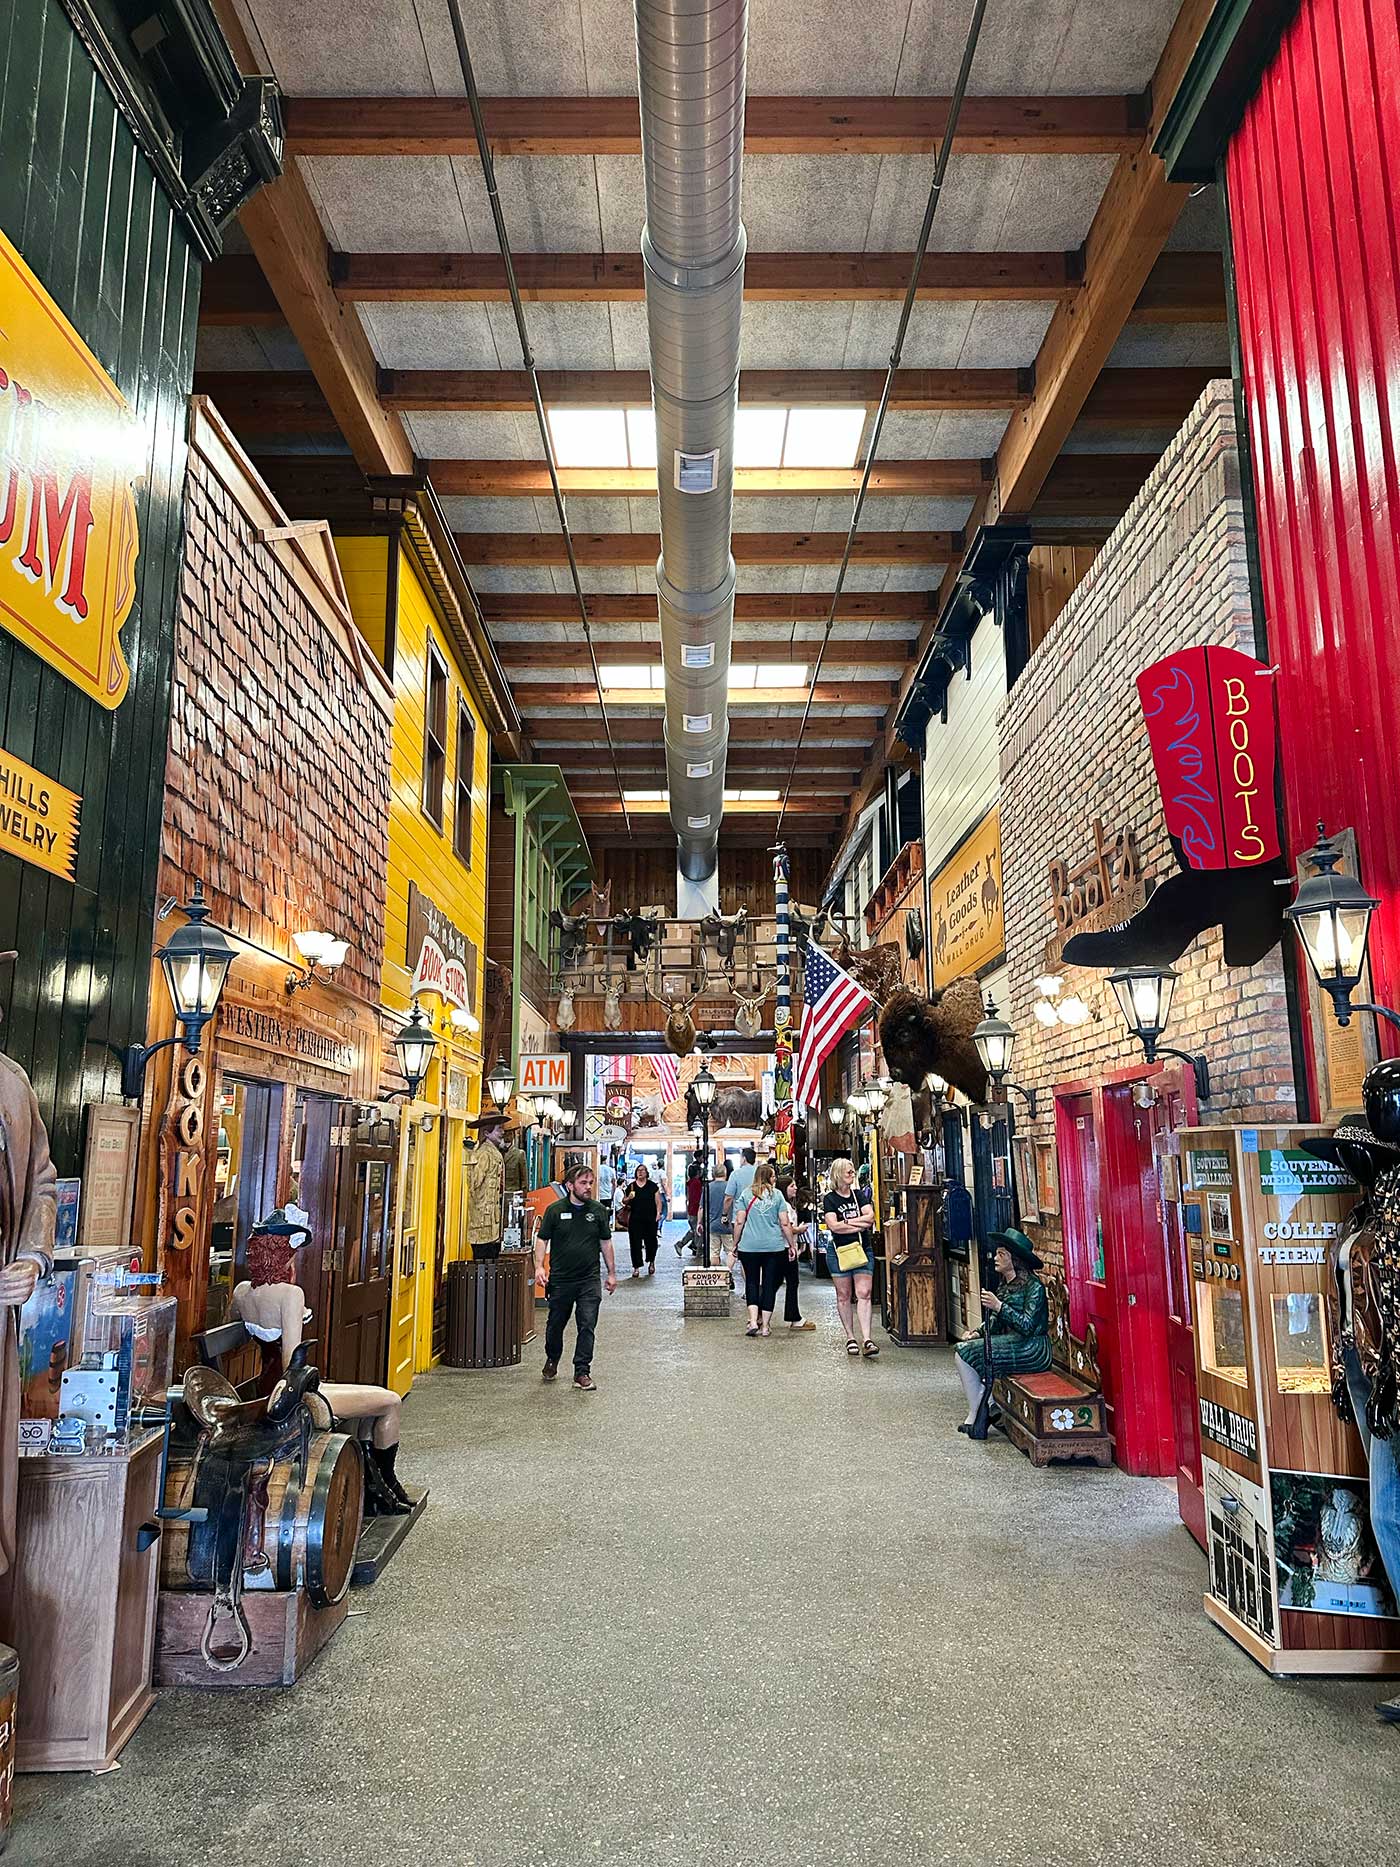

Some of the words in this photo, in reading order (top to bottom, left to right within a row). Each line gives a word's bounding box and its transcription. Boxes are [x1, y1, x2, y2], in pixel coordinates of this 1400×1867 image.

[1223, 677, 1265, 861] BOOTS
[0, 765, 50, 818] HILLS
[945, 860, 981, 908] Leather
[1048, 817, 1140, 932] Boots
[949, 891, 978, 931] Goods
[419, 945, 443, 986] BOOK
[946, 949, 964, 966] WALL
[965, 926, 985, 952] DRUG
[445, 967, 466, 1007] STORE
[223, 1003, 282, 1047] WESTERN
[295, 1026, 353, 1070] PERIODICALS
[523, 1060, 565, 1087] ATM
[607, 1088, 630, 1097] WALL
[173, 1057, 207, 1250] OOKS
[1196, 1156, 1229, 1169] SOUVENIR
[1270, 1160, 1345, 1171] SOUVENI
[1261, 1174, 1357, 1186] MEDALLIONS
[1258, 1247, 1327, 1265] THEM
[1199, 1398, 1227, 1436] WALL
[1228, 1411, 1257, 1451] DRUG
[1215, 1431, 1230, 1447] SOUTH
